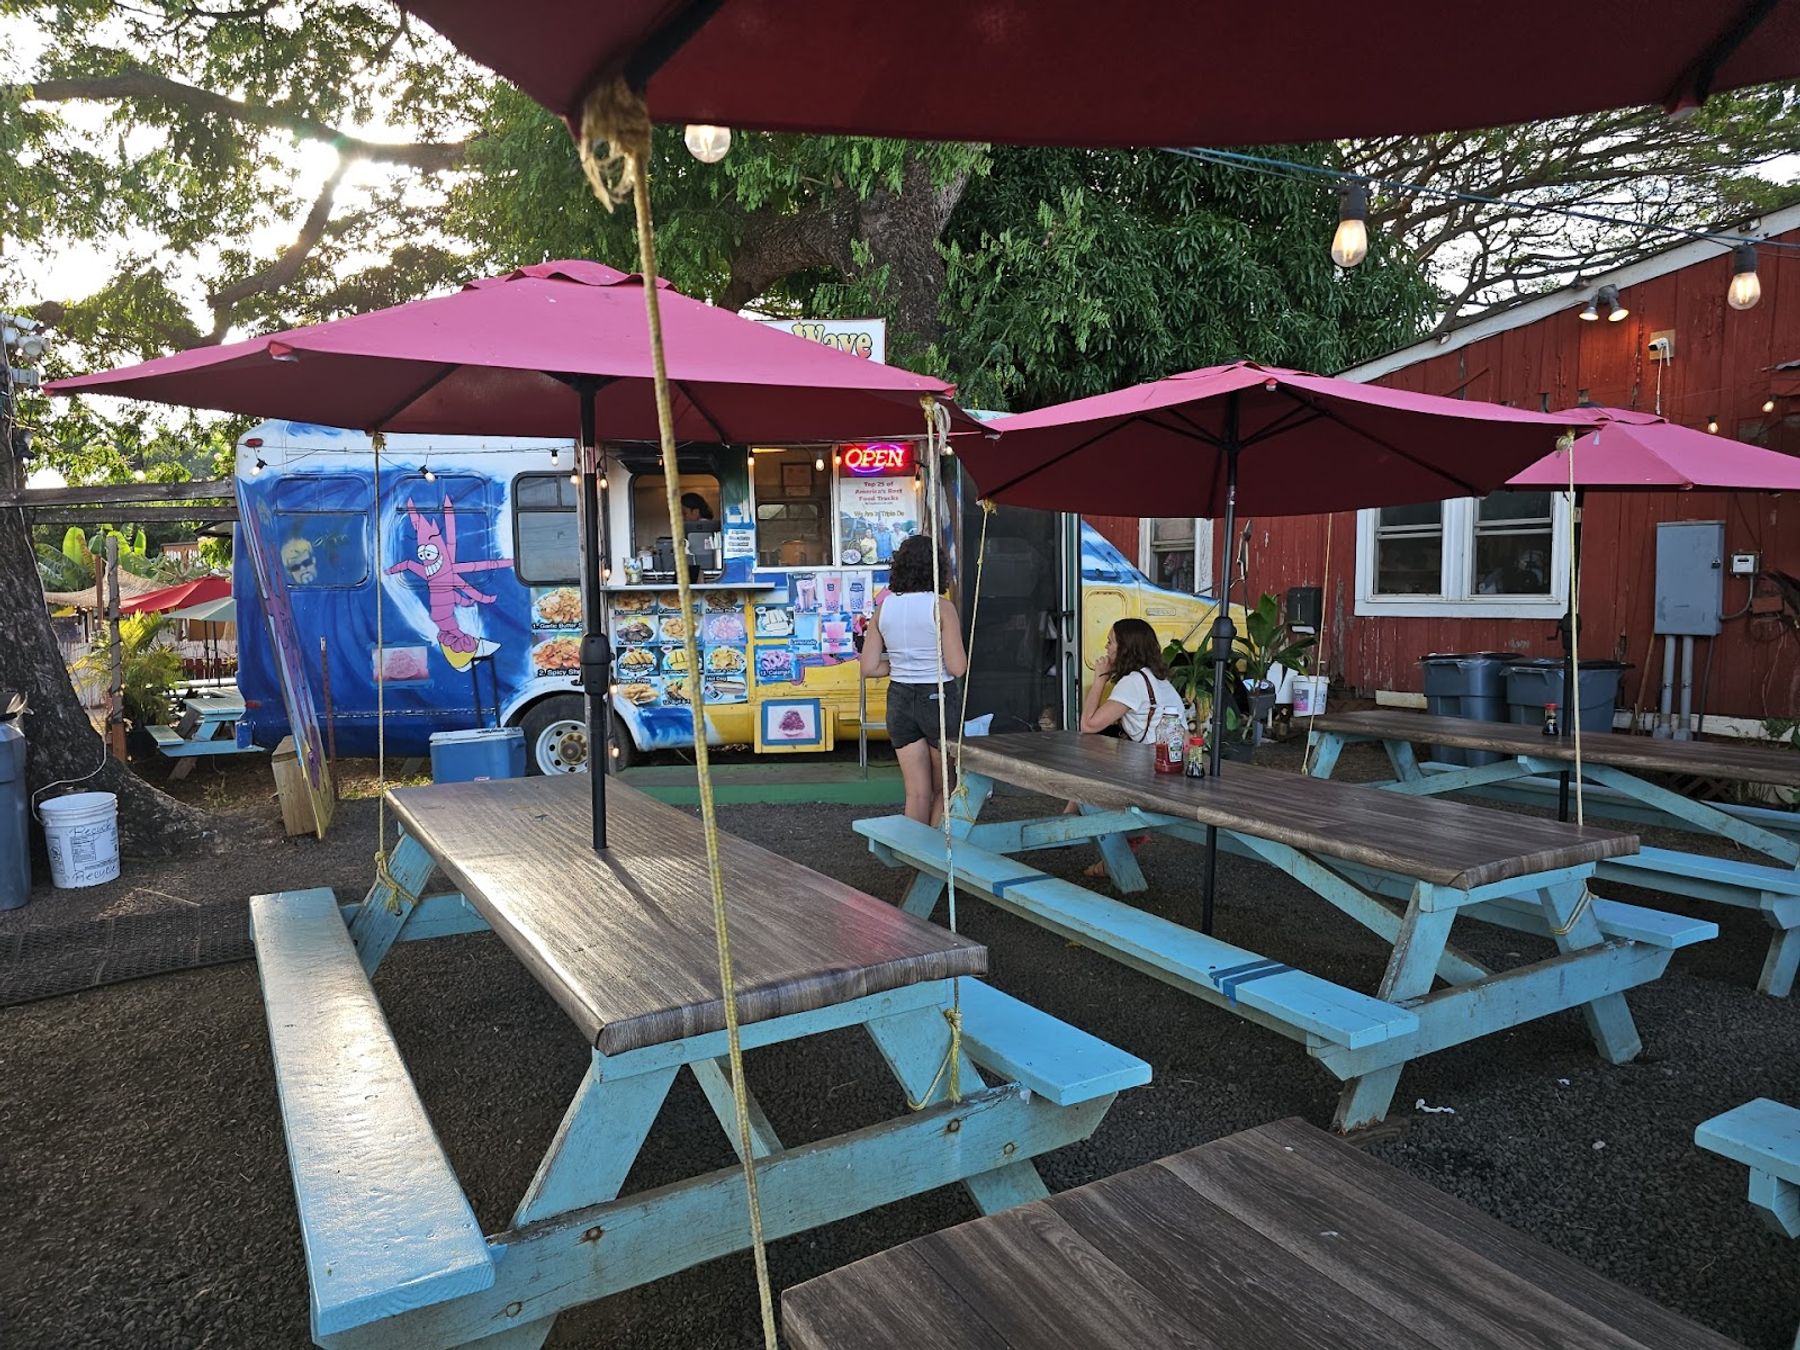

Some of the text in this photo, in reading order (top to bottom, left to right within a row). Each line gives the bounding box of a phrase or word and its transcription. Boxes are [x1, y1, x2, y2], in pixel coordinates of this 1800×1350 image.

[791, 323, 873, 359] Wave
[845, 448, 904, 468] OPEN
[547, 669, 567, 677] Spicy
